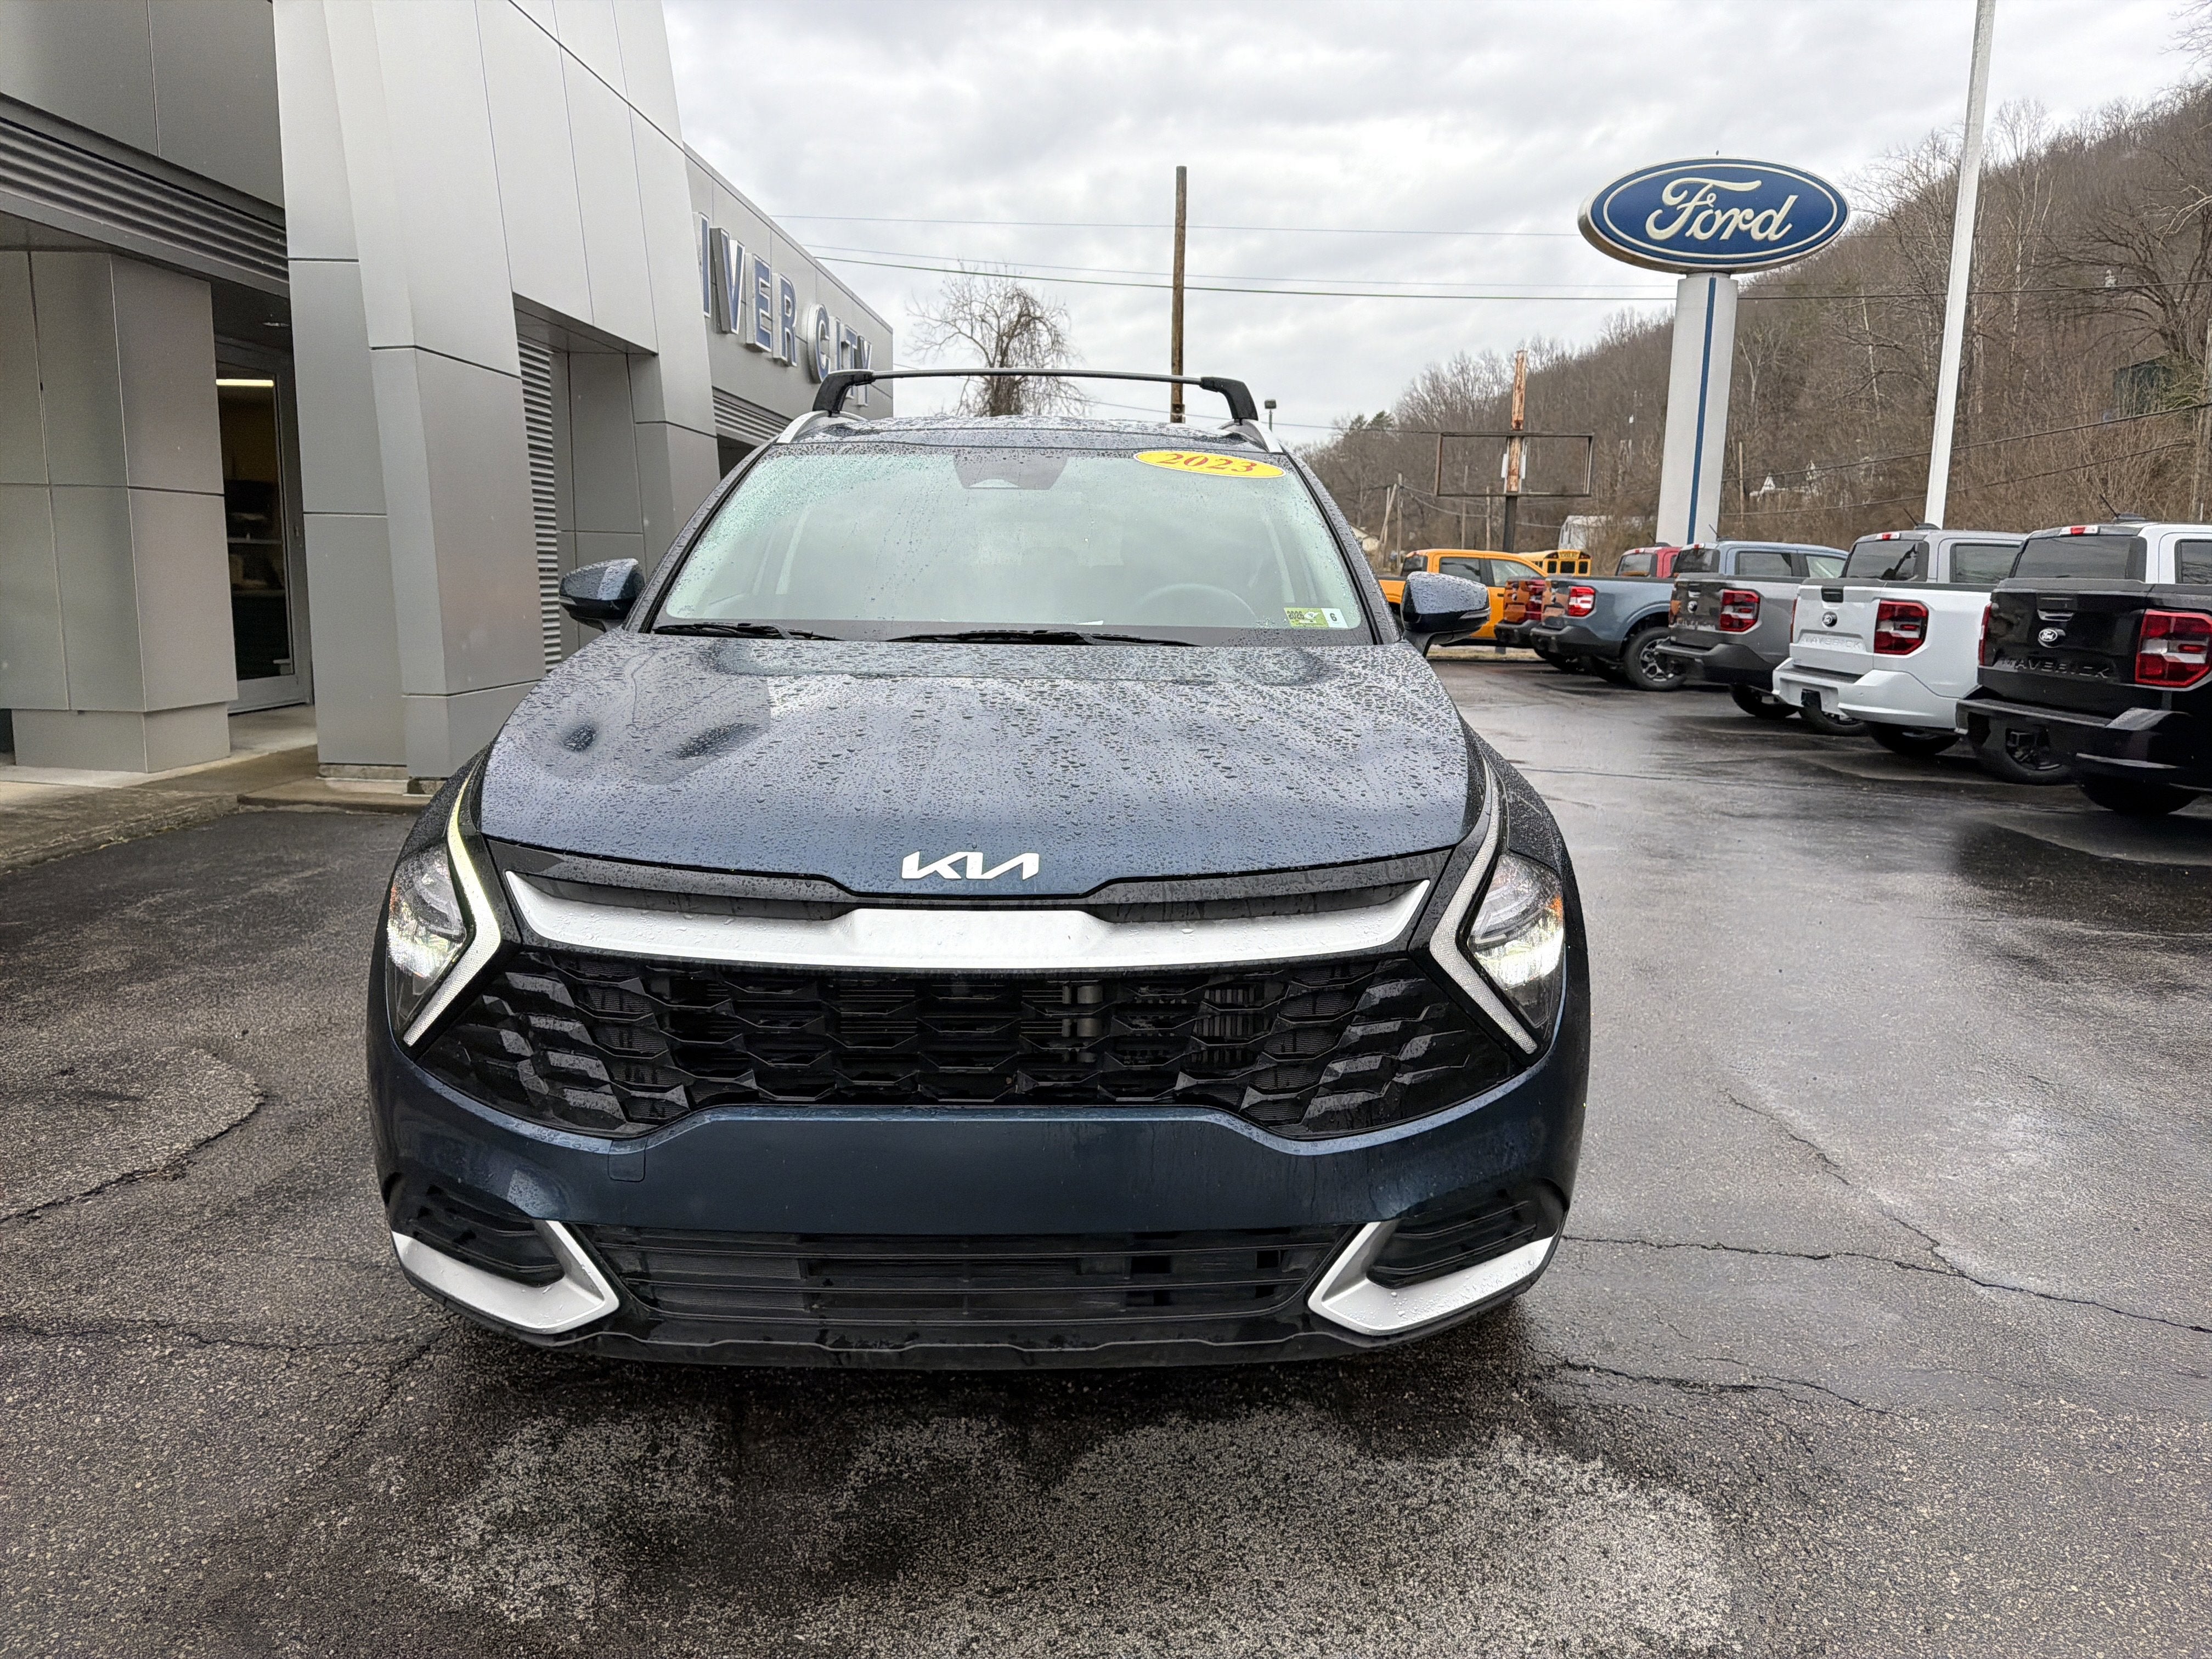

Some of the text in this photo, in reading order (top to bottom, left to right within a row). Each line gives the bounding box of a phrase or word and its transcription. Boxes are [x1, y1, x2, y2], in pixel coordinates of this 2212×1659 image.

[1645, 177, 1799, 241] Ford
[693, 212, 872, 407] IVER CITY
[1156, 453, 1257, 472] 2023
[1286, 610, 1338, 622] 2026 6
[1802, 636, 1863, 649] MAVERCK
[2002, 659, 2110, 679] MAVERCK
[901, 851, 1039, 880] KIA
